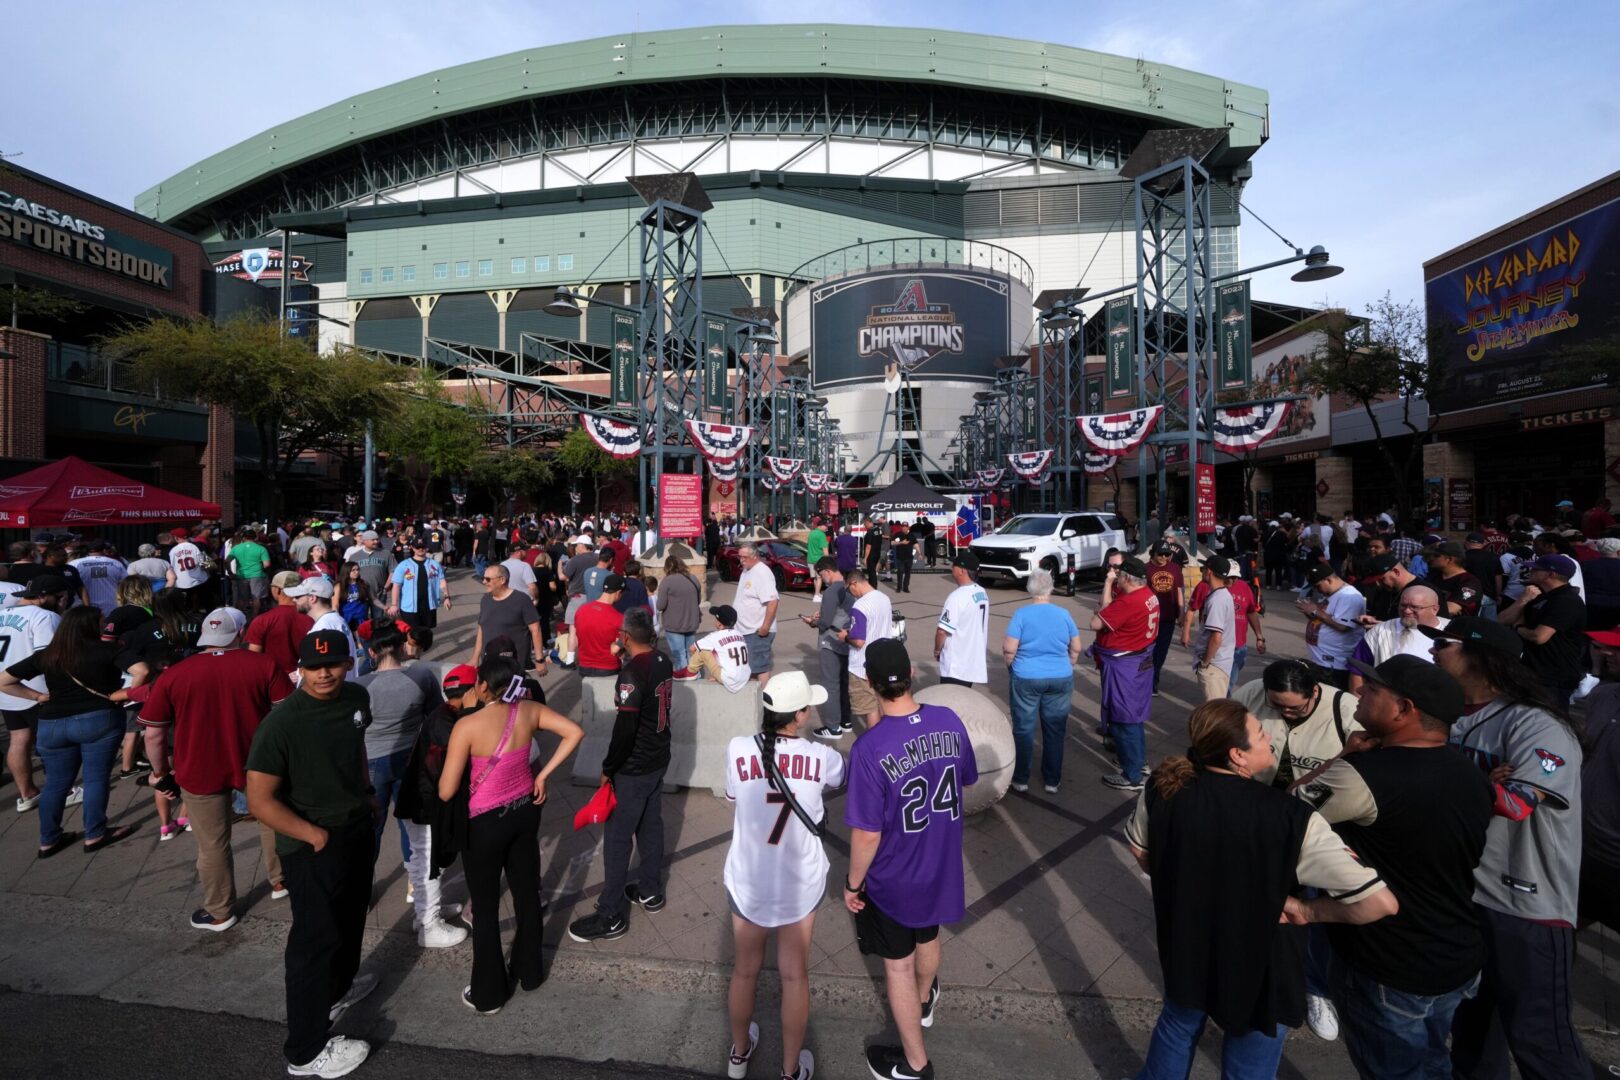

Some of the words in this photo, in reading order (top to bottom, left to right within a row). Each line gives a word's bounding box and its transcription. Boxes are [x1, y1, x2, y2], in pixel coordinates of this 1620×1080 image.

[0, 191, 105, 241] CAESARS
[0, 211, 168, 288] SPORTSBOOK
[215, 259, 240, 273] HASE
[1465, 265, 1492, 303] DEF
[1494, 228, 1581, 289] LEPPARD
[1222, 285, 1243, 295] 2023
[1457, 272, 1587, 334] JOURNEY
[870, 314, 915, 324] NATIONAL
[917, 314, 952, 322] LEAGUE
[859, 325, 963, 354] CHAMPIONS
[1226, 331, 1234, 371] CHAMPIONS
[1509, 376, 1533, 386] AUGUST
[1520, 405, 1612, 430] TICKETS
[1284, 452, 1319, 462] TICKETS
[76, 487, 141, 496] Budweiser
[0, 511, 10, 520] OU.
[121, 510, 139, 518] THIS
[168, 509, 185, 517] FOR
[177, 557, 195, 571] 10
[1145, 612, 1158, 639] 5
[728, 645, 748, 666] 40
[880, 731, 961, 783] McMAHON
[902, 765, 960, 833] 24
[766, 792, 796, 845] 7
